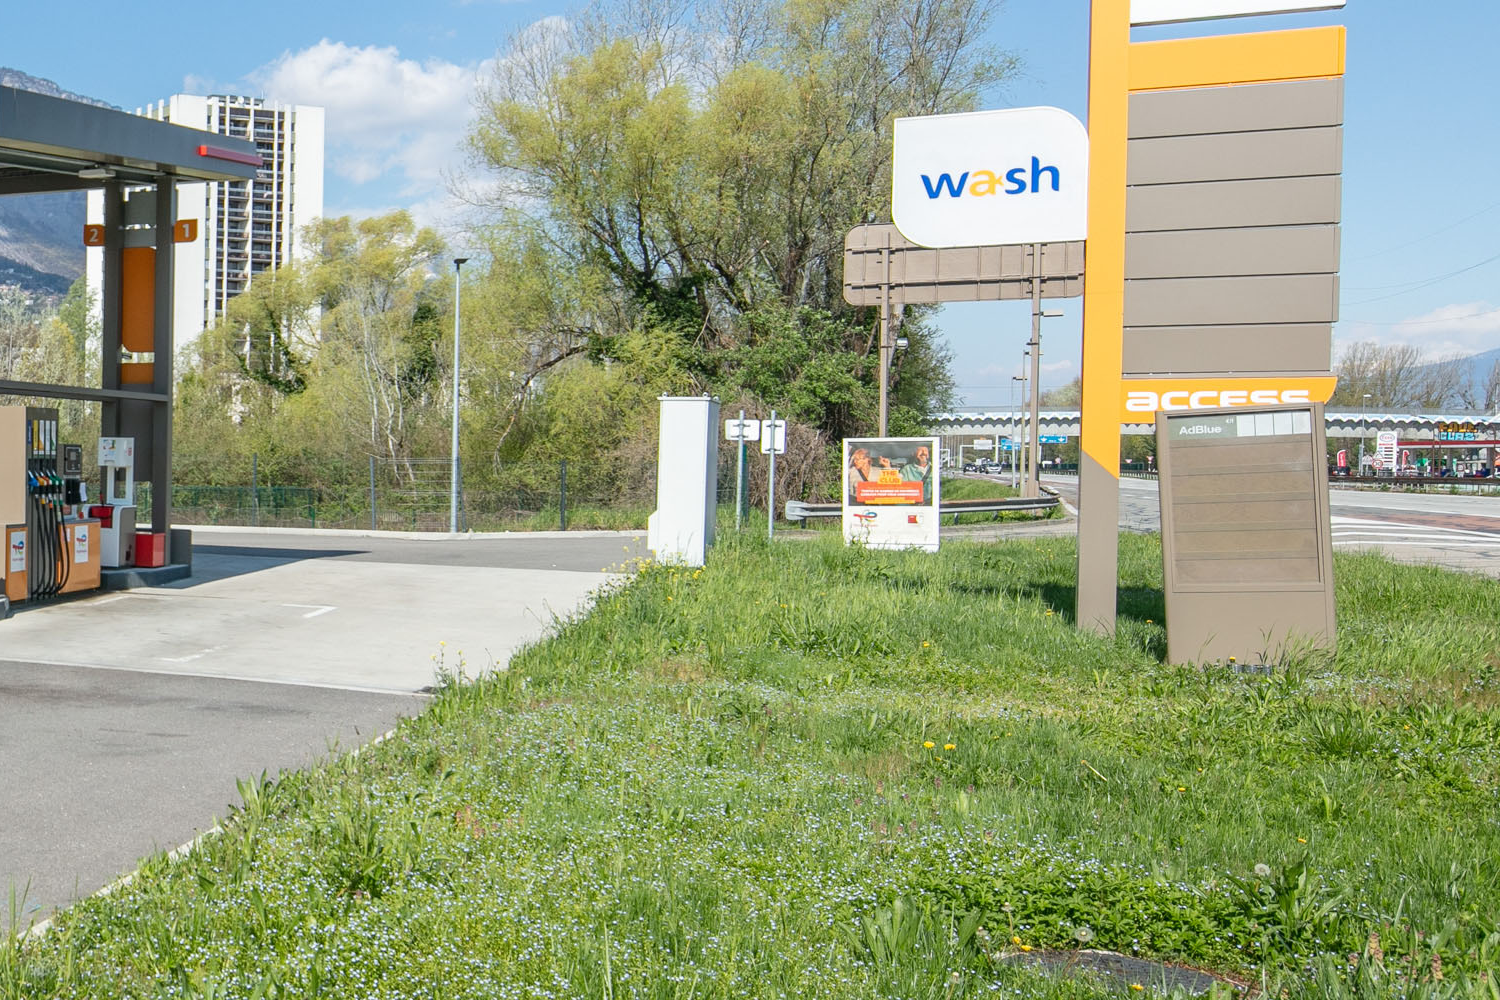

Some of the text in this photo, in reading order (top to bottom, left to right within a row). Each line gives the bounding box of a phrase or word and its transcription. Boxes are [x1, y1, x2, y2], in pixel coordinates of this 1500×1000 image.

[920, 155, 1060, 199] wash
[88, 228, 99, 242] 2
[182, 223, 190, 238] 1
[1125, 390, 1310, 412] access
[1179, 425, 1222, 435] AdBlue
